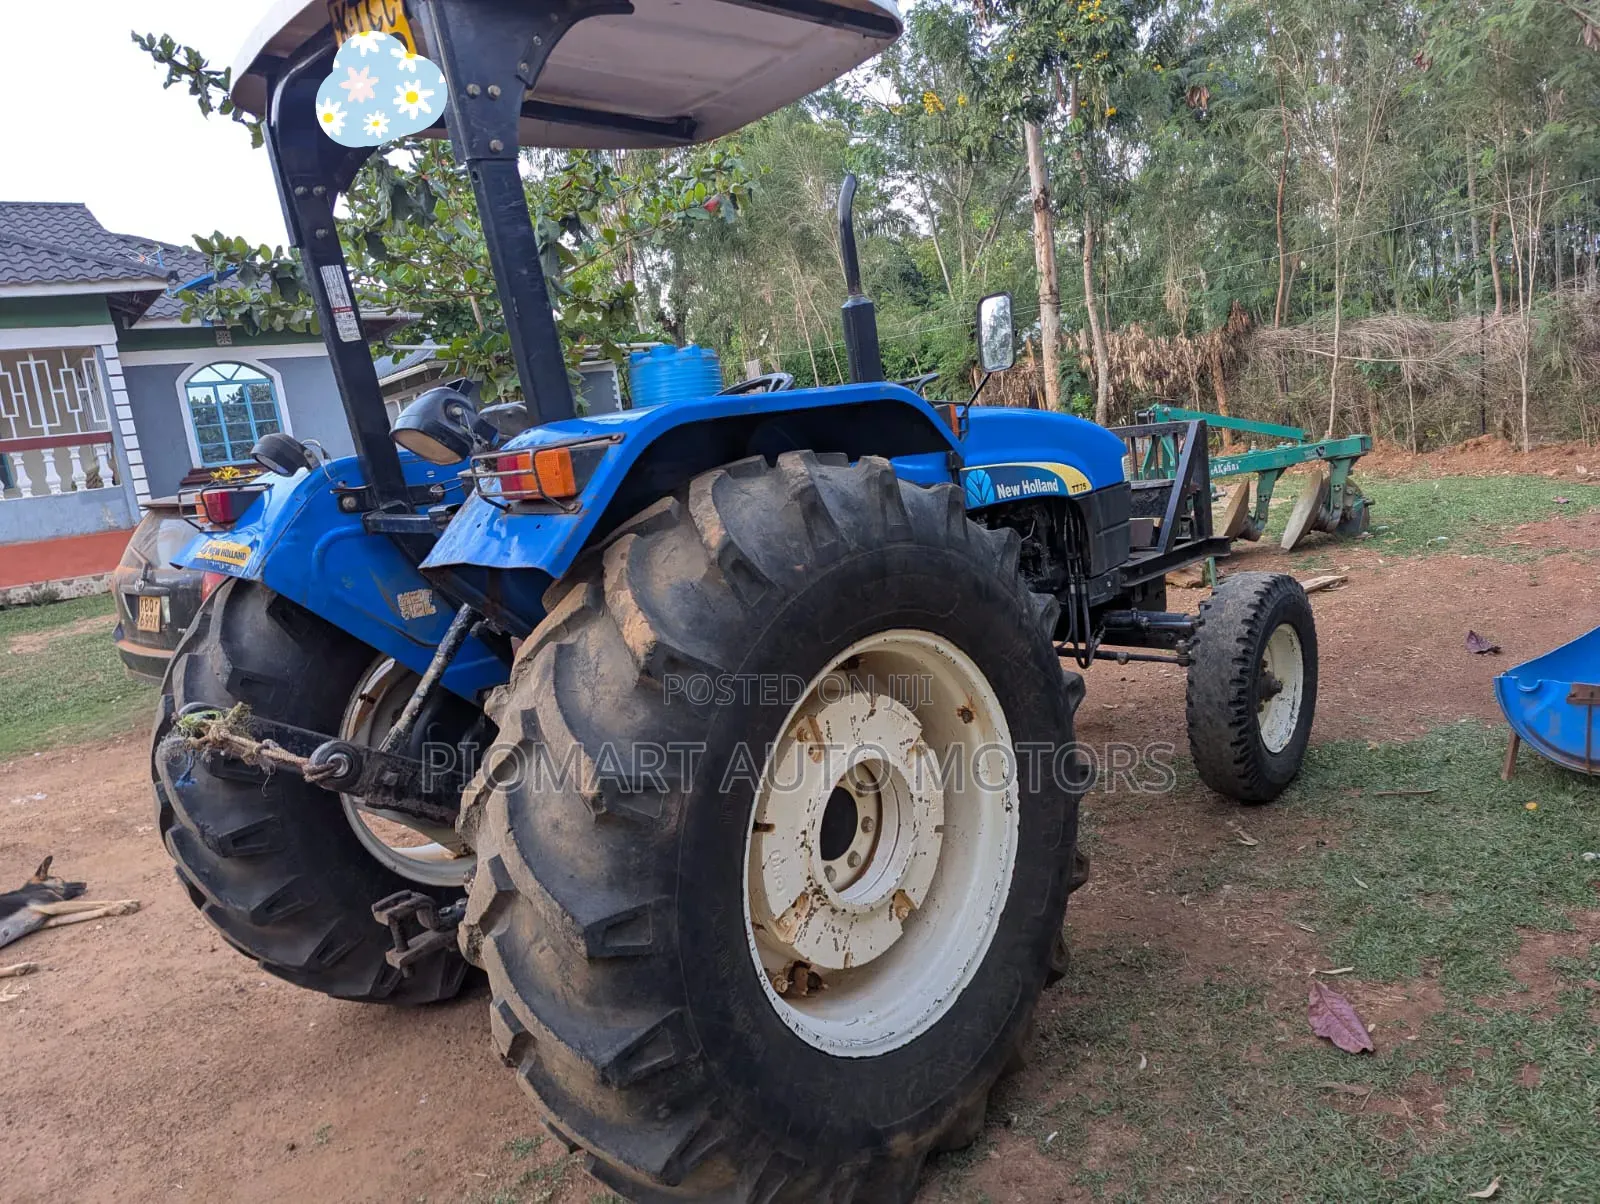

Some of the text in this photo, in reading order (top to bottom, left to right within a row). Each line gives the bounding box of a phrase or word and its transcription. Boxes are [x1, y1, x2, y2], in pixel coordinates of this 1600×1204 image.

[996, 478, 1059, 499] New Holland
[1071, 483, 1087, 493] TT75
[208, 546, 247, 561] NEW HOLLAND
